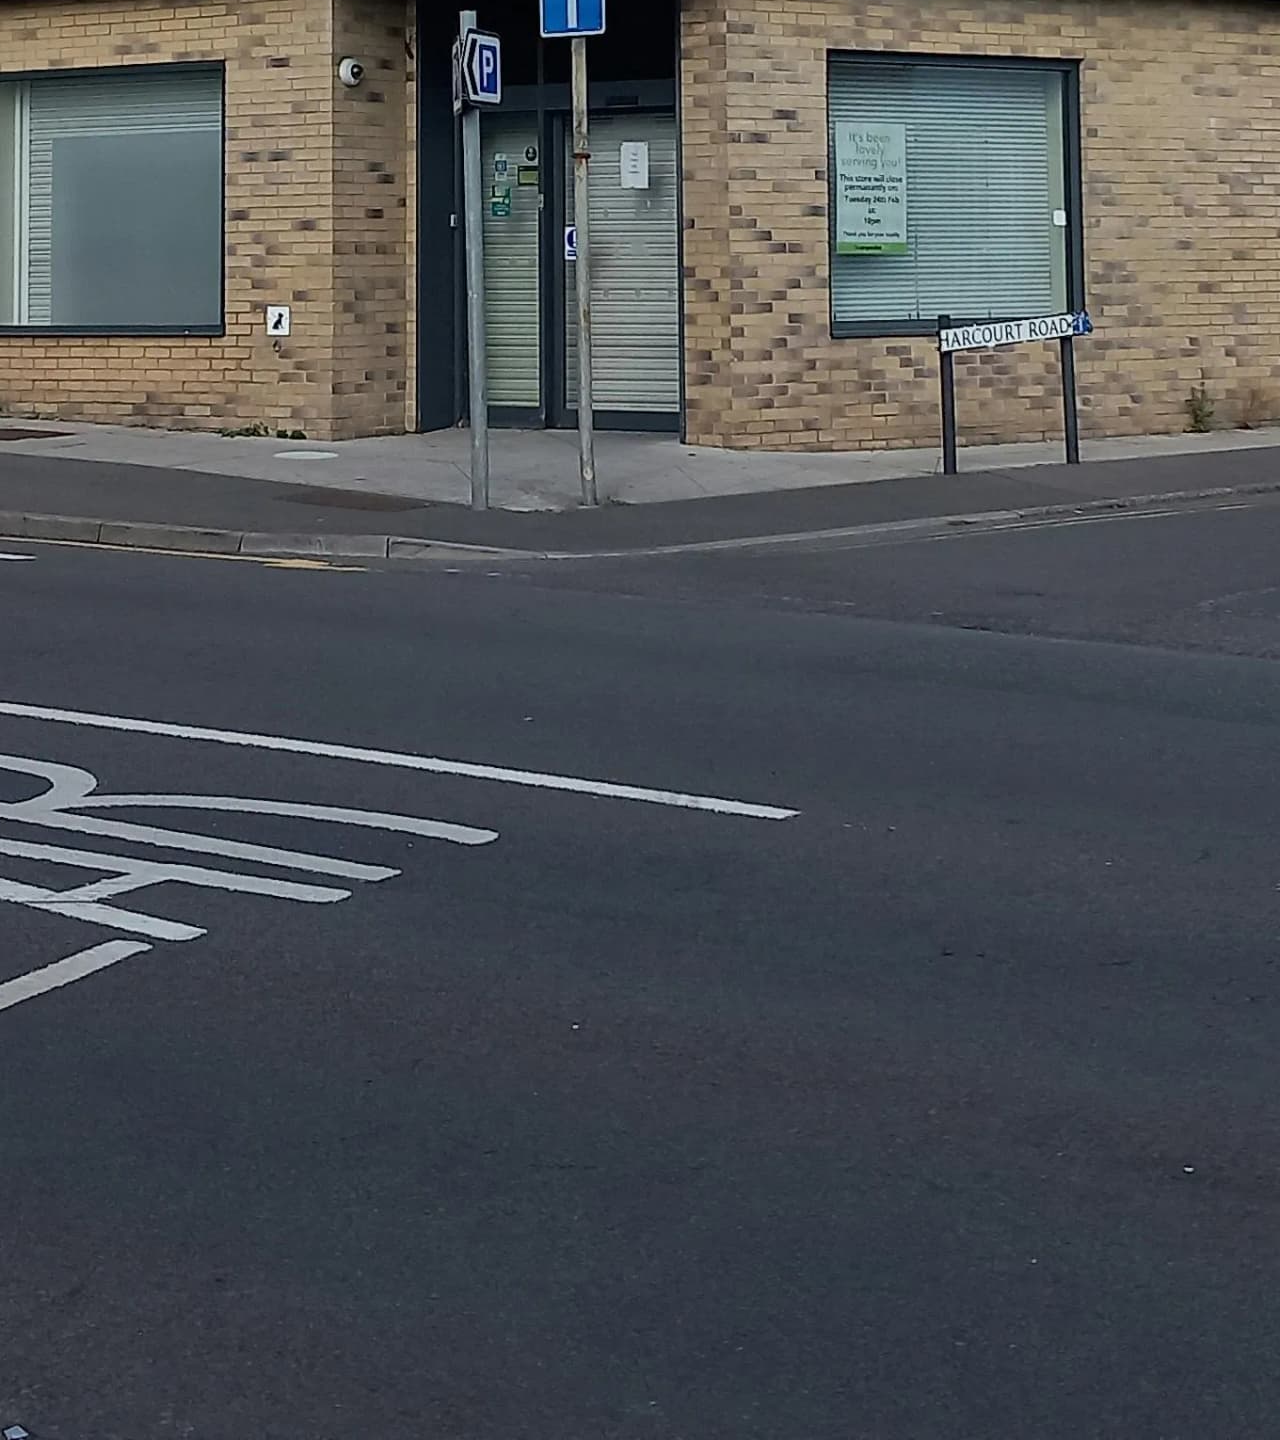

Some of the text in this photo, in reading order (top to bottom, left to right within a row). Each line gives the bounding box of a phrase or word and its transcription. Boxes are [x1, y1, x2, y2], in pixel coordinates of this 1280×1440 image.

[483, 49, 494, 88] P
[866, 131, 890, 143] been
[855, 142, 885, 157] lovely
[840, 174, 853, 182] This
[845, 195, 872, 204] Tuesday
[941, 317, 1070, 348] HARCOURT ROAD
